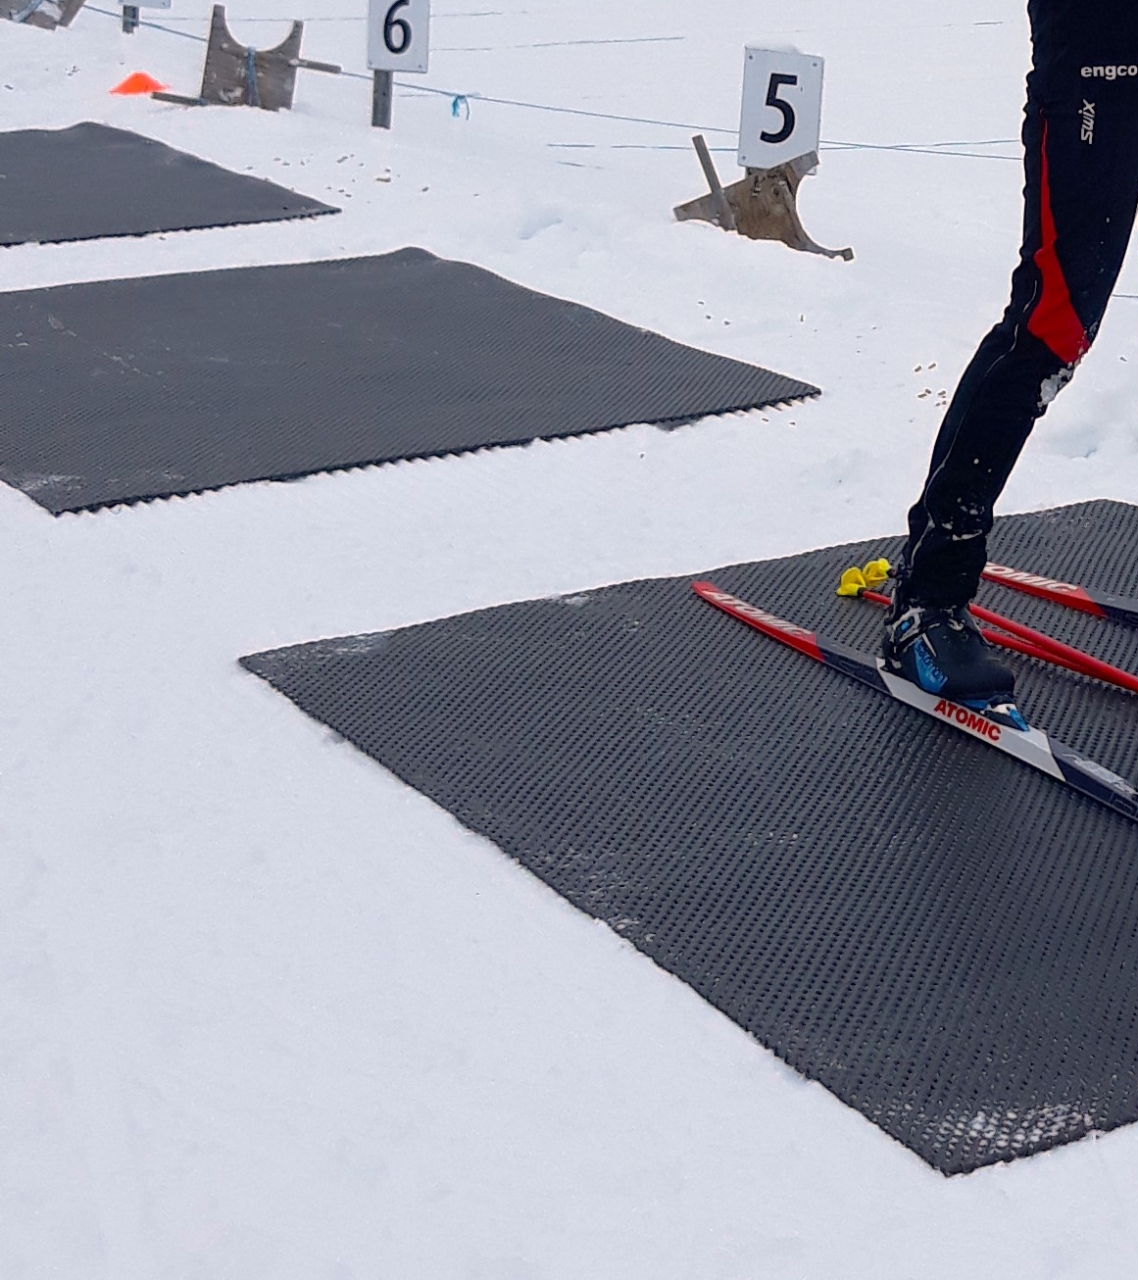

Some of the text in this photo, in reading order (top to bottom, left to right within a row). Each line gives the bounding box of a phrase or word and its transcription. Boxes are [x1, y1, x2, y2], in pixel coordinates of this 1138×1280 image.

[760, 72, 798, 144] 5
[1078, 98, 1096, 145] swix
[974, 561, 1079, 593] OMIC
[701, 589, 813, 636] ATOMIC
[933, 698, 1002, 742] ATOMIC
